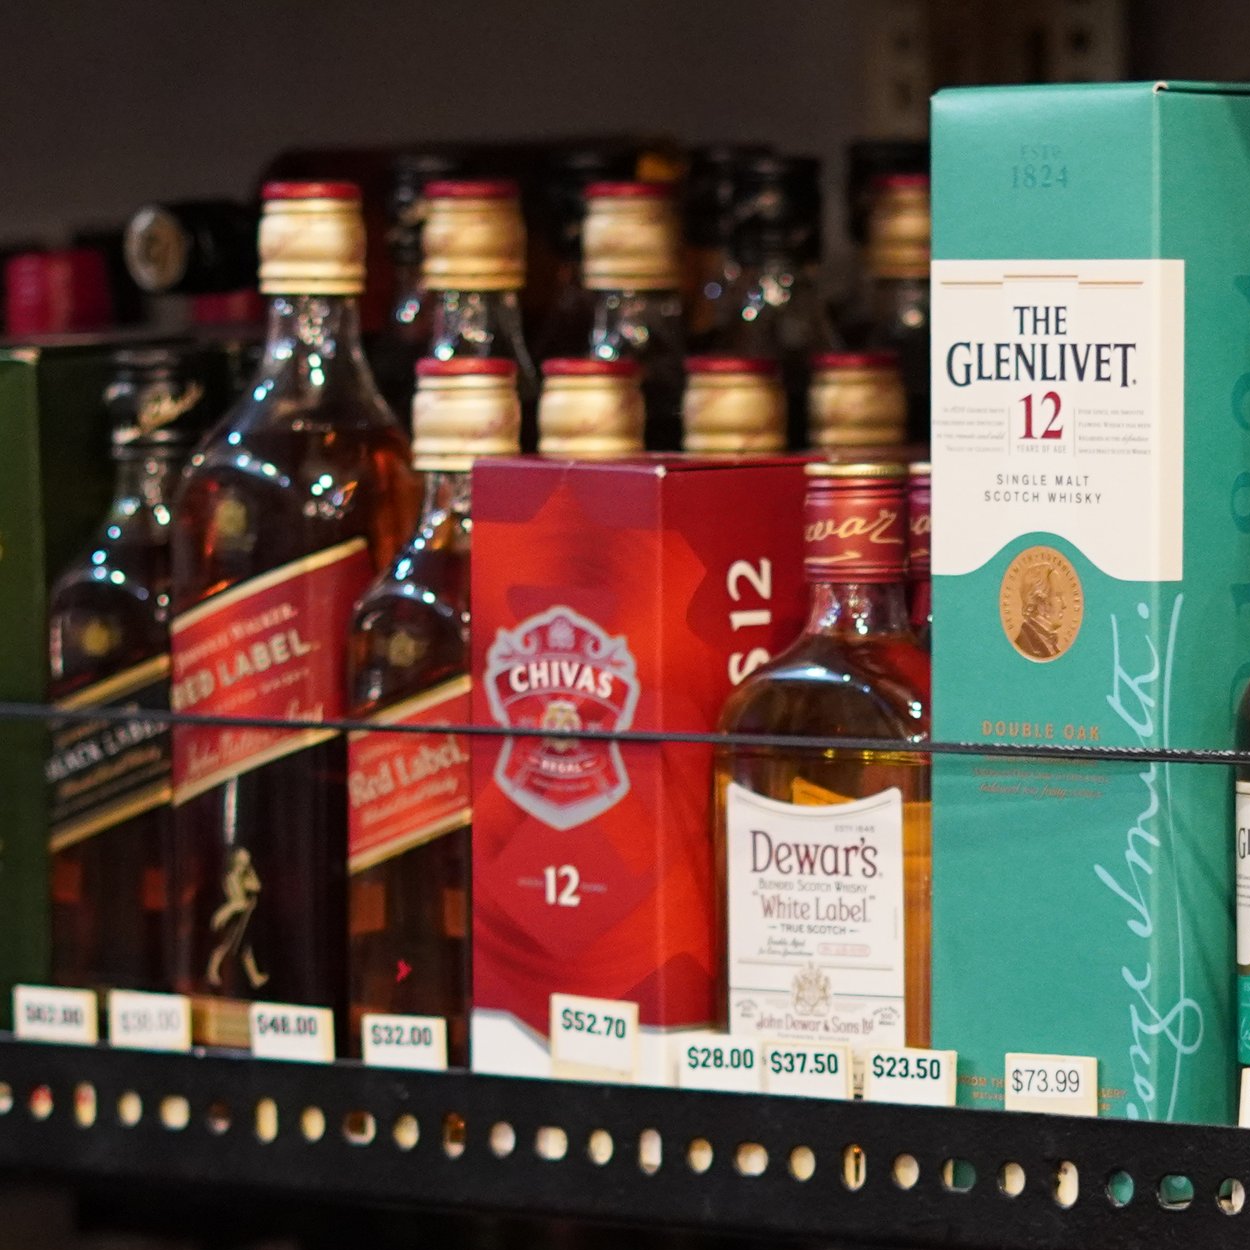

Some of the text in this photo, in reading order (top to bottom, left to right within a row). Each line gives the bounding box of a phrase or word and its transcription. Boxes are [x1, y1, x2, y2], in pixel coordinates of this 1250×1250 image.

[1011, 164, 1069, 189] 1824
[1013, 305, 1067, 335] THE
[1018, 391, 1064, 440] 12
[996, 474, 1089, 486] SINGLE MALT
[984, 491, 1102, 504] SCOTCH WHISKY
[508, 662, 614, 701] CHIVAS
[982, 721, 1100, 741] DOUBLE OAK
[750, 830, 878, 878] Dewar's
[543, 864, 581, 907] 12
[781, 924, 847, 935] TRUE SCOTCH
[371, 1024, 432, 1046] $32.00
[561, 1009, 627, 1040] $52.70
[785, 1017, 821, 1032] Dewar
[687, 1045, 755, 1070] $28.00
[770, 1050, 839, 1076] $37.50
[872, 1055, 941, 1081] $23.50
[1012, 1069, 1080, 1093] $73.99
